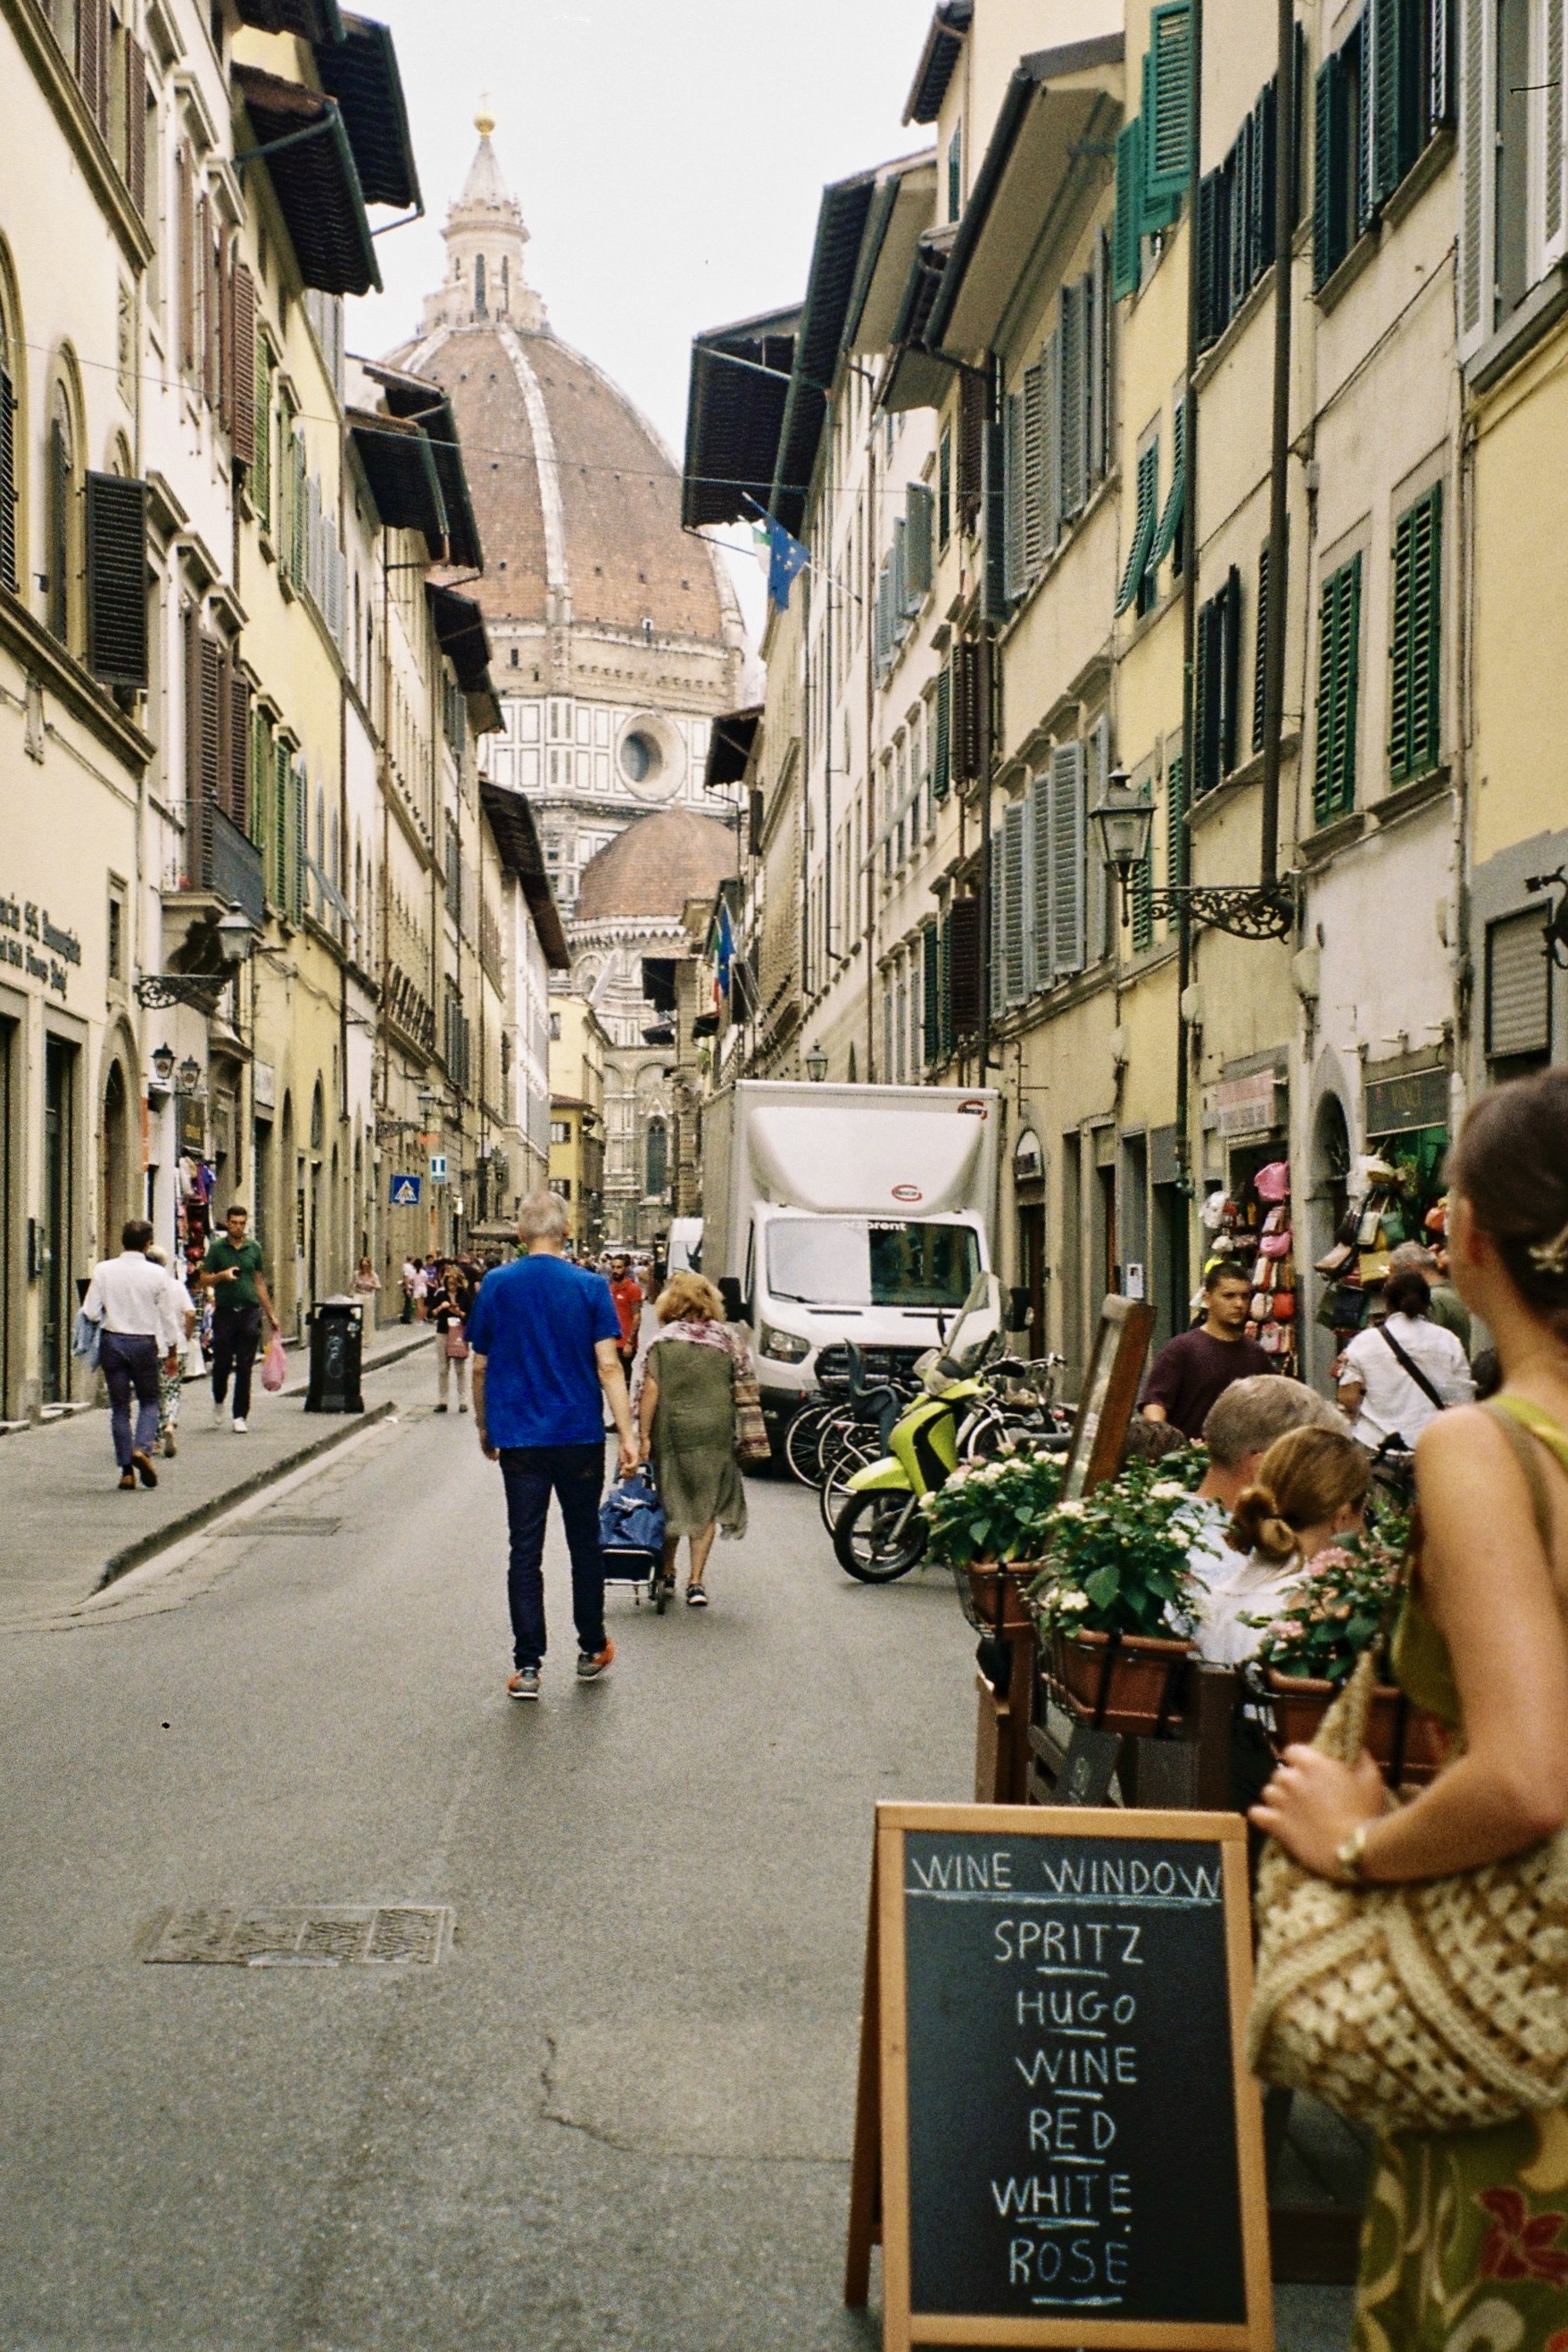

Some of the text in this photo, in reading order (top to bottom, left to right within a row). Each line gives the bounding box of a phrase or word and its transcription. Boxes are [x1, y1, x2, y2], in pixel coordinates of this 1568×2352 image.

[911, 1852, 1222, 1899] WINE WINDOW
[993, 1919, 1144, 1965] SPRITZ
[1016, 1990, 1137, 2025] HUGO
[1015, 2046, 1138, 2086] WINE
[1028, 2107, 1116, 2151] RED
[991, 2173, 1133, 2216] WHITE
